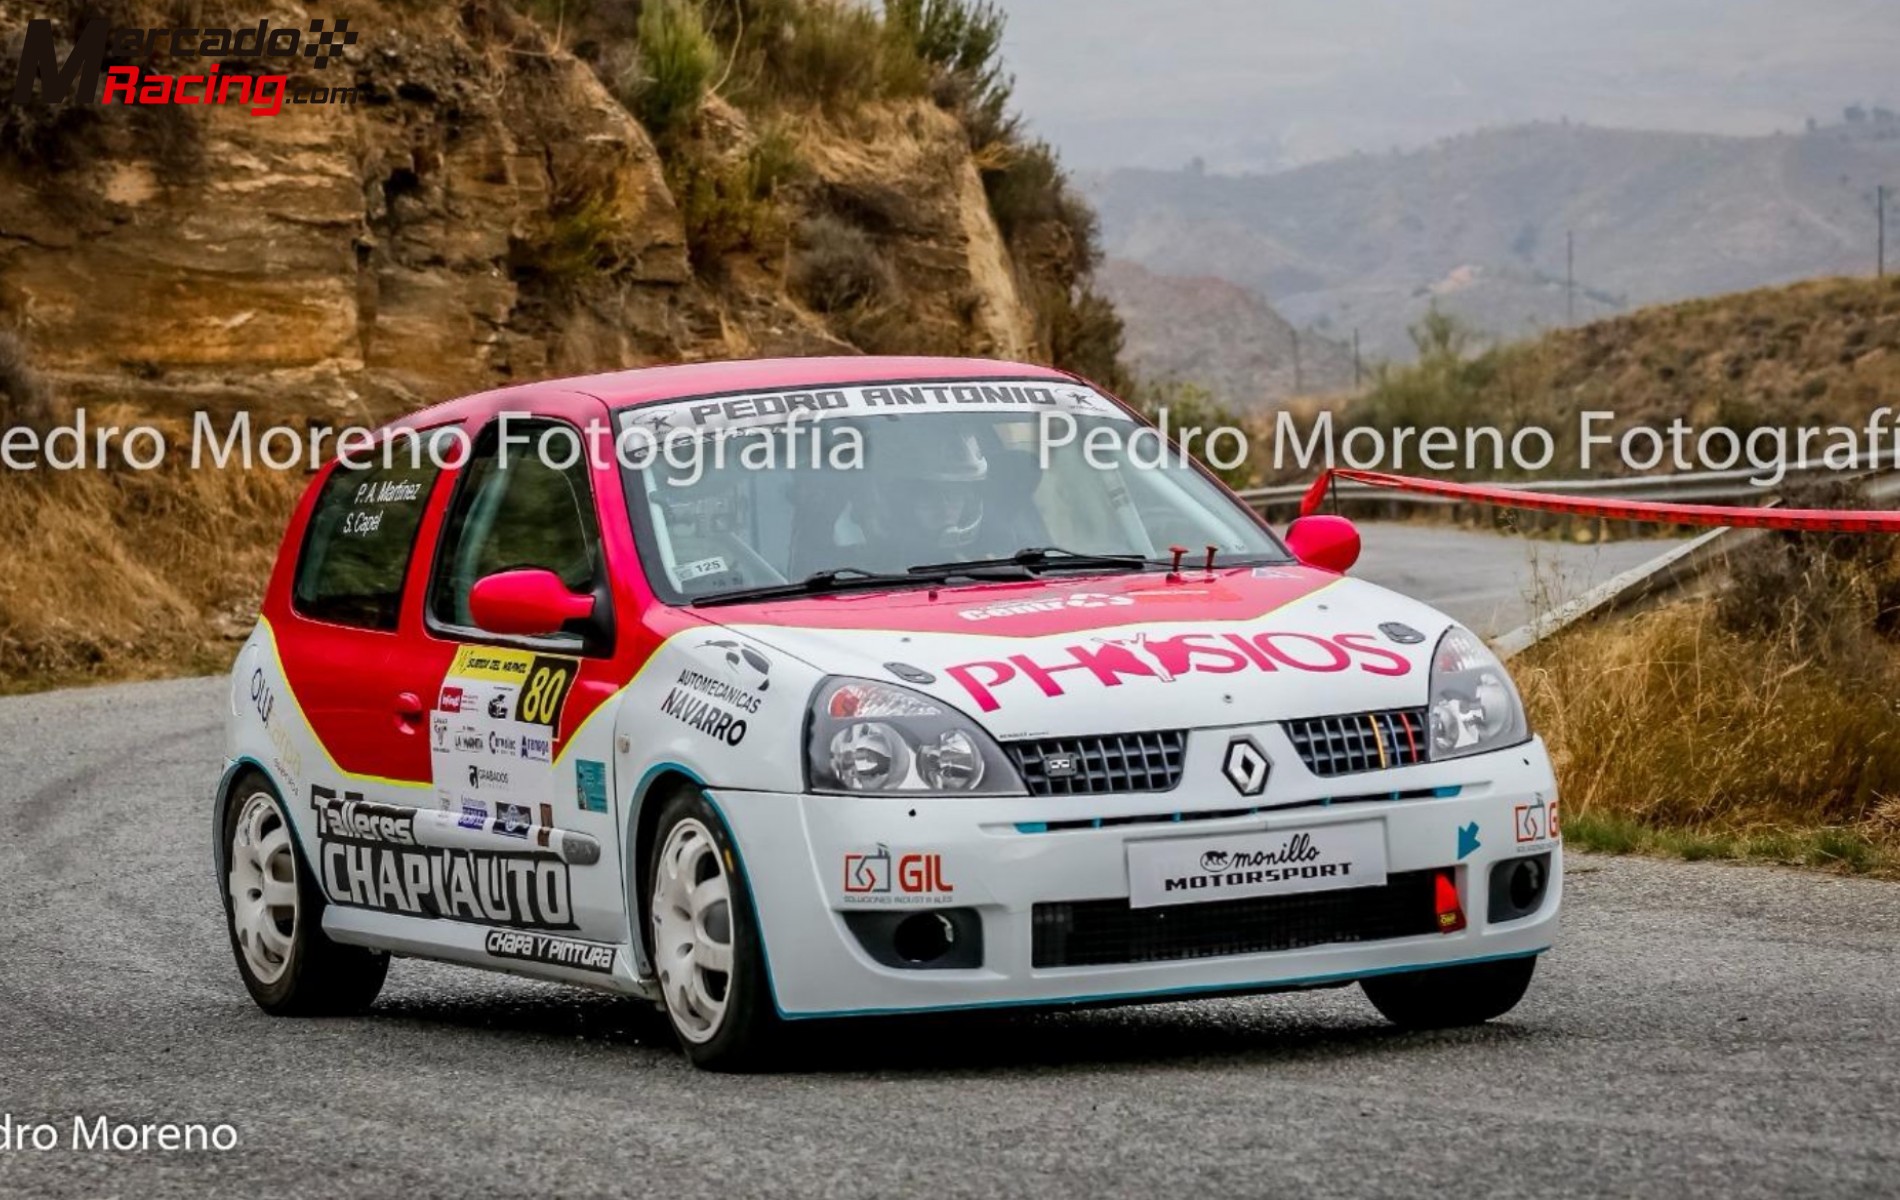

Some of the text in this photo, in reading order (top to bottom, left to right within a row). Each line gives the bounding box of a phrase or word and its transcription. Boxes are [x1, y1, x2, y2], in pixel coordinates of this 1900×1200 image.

[690, 386, 1057, 425] PEDRO ANTONIO
[523, 666, 567, 724] 80
[677, 669, 762, 714] AUTOMECANICAS
[661, 686, 748, 747] NAVARRO
[313, 794, 415, 845] Talleres
[1231, 833, 1320, 868] monillo
[899, 855, 953, 892] GIL
[1165, 862, 1353, 891] MOTORSPORT
[537, 937, 549, 957] Y
